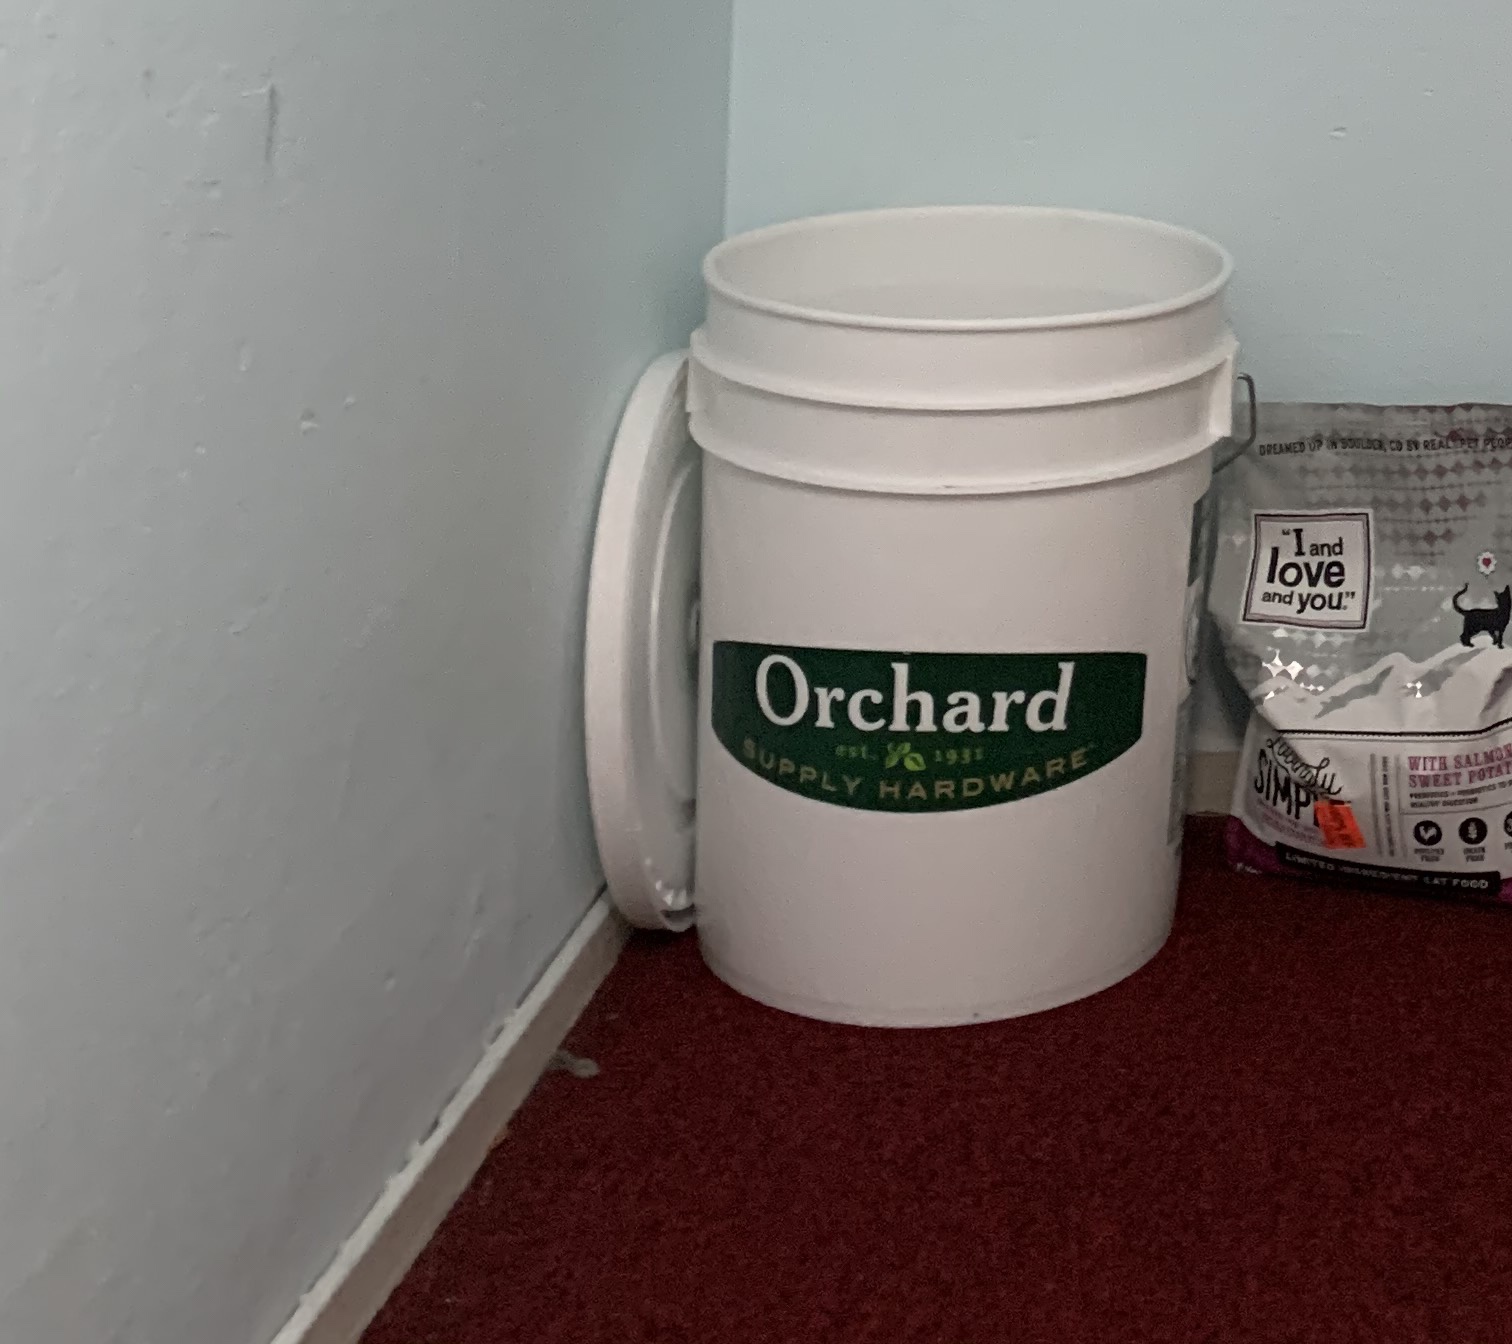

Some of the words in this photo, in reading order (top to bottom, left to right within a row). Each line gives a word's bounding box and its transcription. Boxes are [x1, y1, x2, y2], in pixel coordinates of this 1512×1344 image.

[1259, 442, 1306, 457] DREAMED
[1423, 437, 1451, 451] REAL
[1309, 536, 1343, 558] and
[1266, 546, 1346, 589] love
[1261, 590, 1294, 606] and
[755, 654, 1075, 733] Orchard
[1408, 756, 1448, 772] WITH
[1453, 743, 1512, 770] SALMON
[744, 737, 862, 796] SUPPLY
[877, 746, 1090, 801] HARDWARE
[1408, 772, 1462, 789] SWEET
[1451, 877, 1489, 890] FOOD
